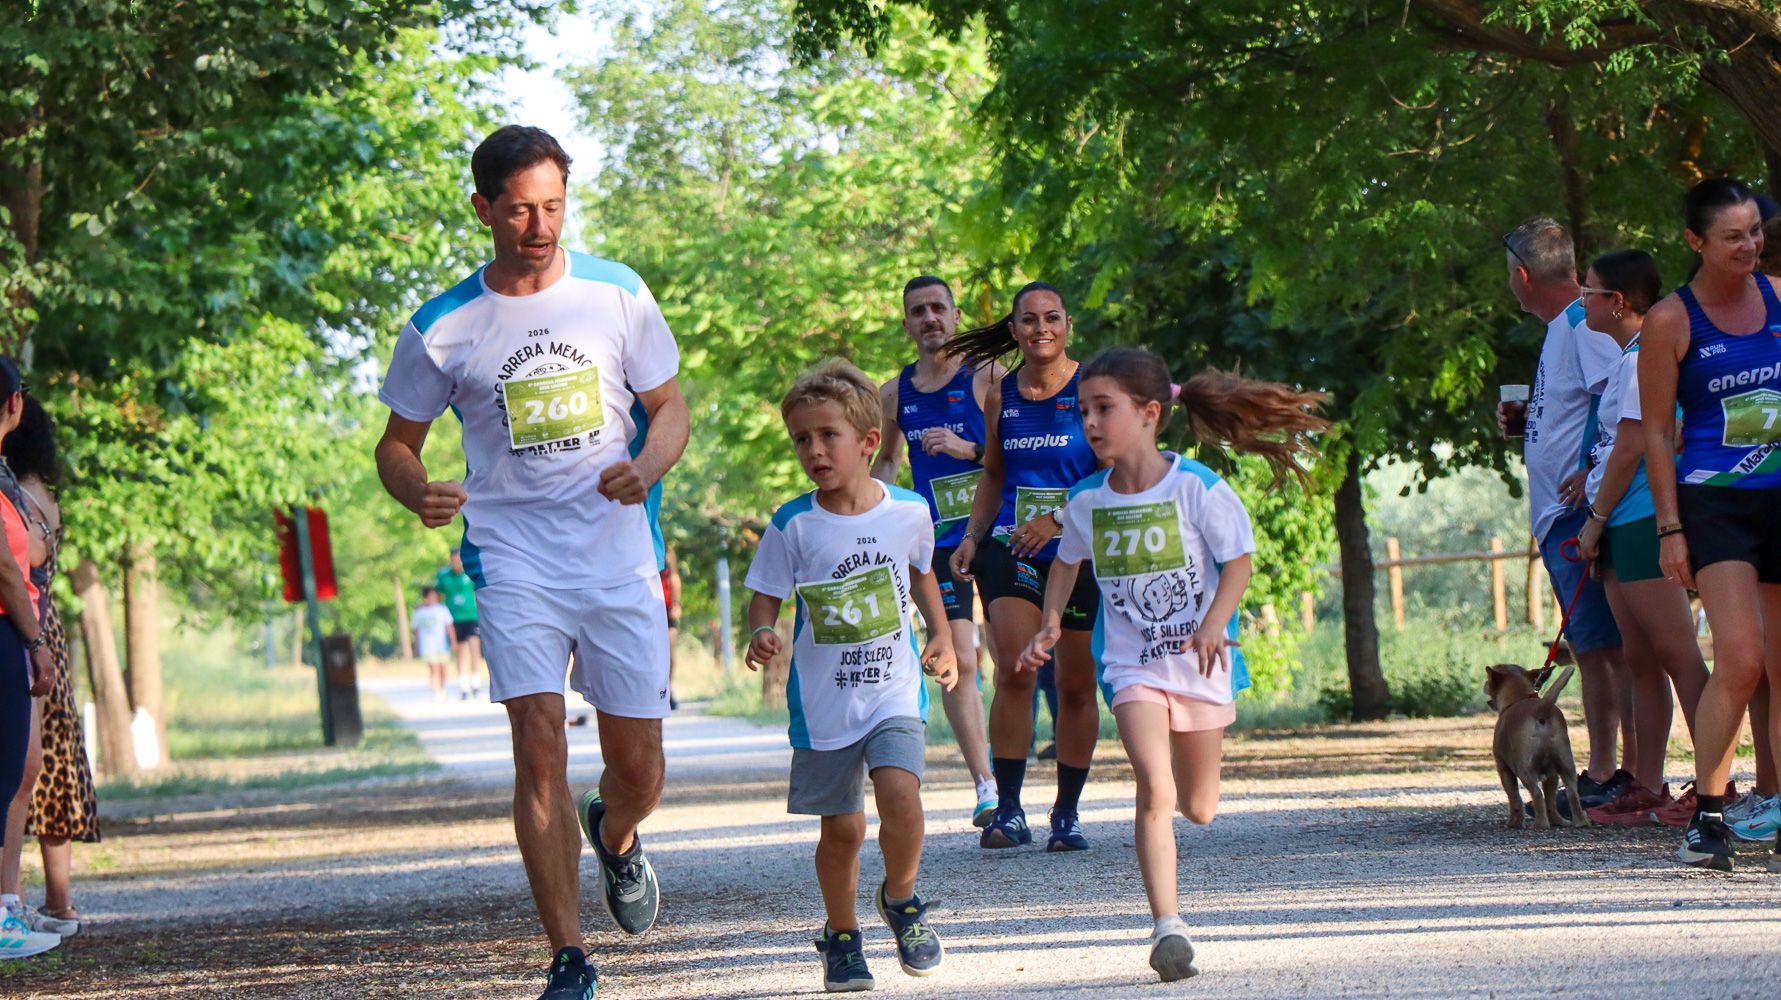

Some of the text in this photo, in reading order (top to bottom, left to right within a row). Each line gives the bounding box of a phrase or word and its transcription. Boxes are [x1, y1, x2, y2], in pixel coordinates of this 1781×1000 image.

[528, 328, 550, 337] 2026
[1708, 362, 1781, 393] enerpl
[525, 391, 588, 425] 260
[1003, 434, 1069, 450] enerplus
[1104, 526, 1166, 557] 270
[821, 593, 880, 626] 261
[1161, 619, 1199, 640] SILLERO
[840, 647, 863, 666] JOSÉ
